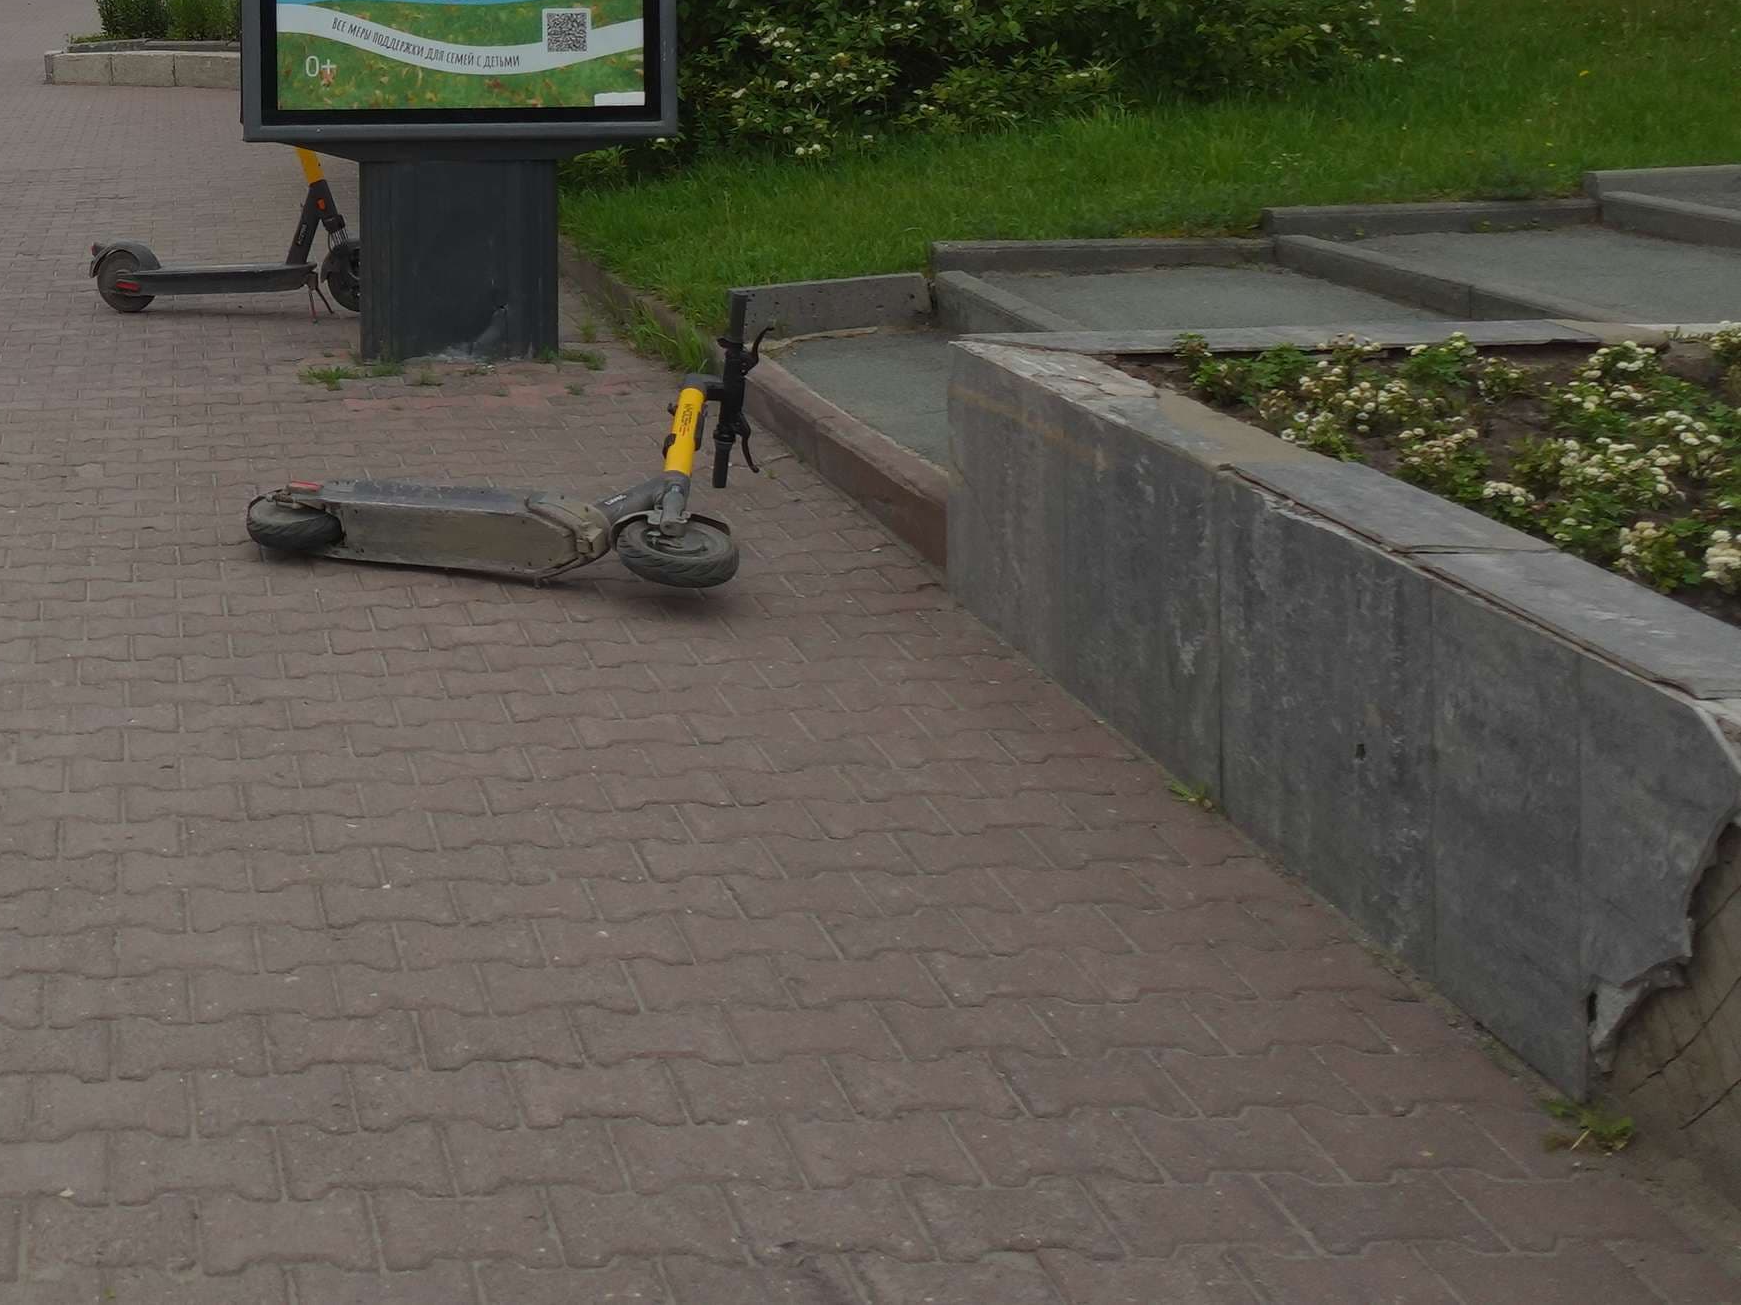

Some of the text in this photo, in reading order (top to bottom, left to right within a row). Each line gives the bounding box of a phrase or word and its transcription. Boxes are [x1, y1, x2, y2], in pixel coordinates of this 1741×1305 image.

[331, 17, 520, 69] ВСЕ МЕРЫ ПОДДЕРЖКИ ДЛЯ СЕМЕЙ С ДЕТЬМИ
[305, 55, 337, 77] 0+
